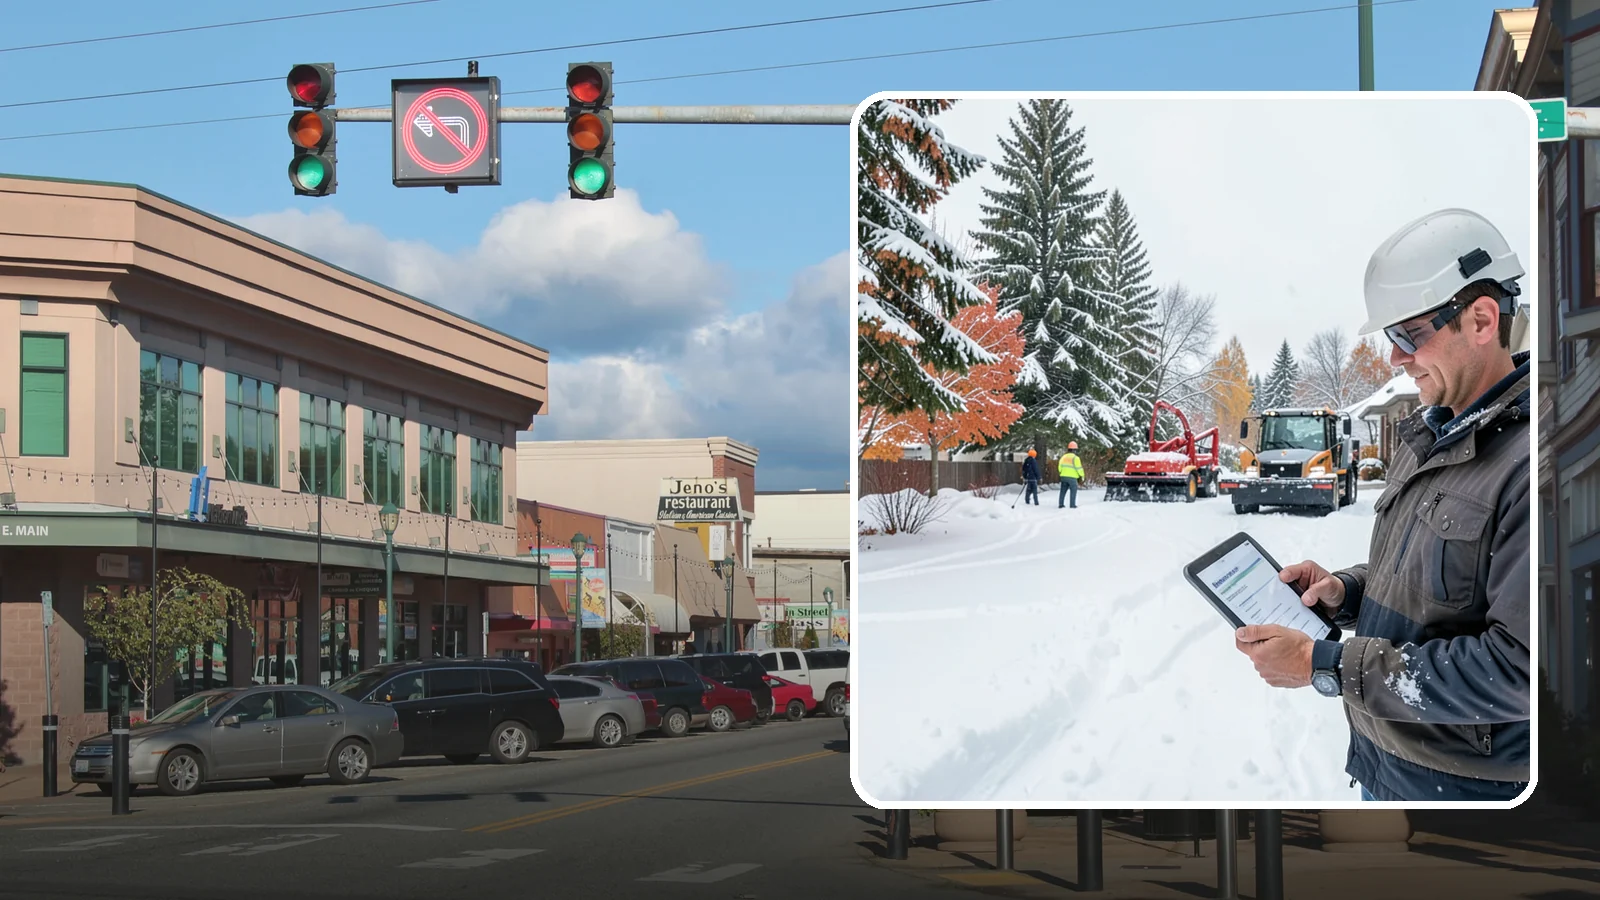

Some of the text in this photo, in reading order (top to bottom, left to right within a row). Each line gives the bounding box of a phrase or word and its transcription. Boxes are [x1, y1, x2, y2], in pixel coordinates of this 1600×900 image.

[670, 480, 727, 494] Jeno's
[665, 496, 731, 509] restaurant
[659, 510, 681, 520] Italian
[686, 509, 714, 519] American
[715, 509, 738, 519] Cuisine
[2, 525, 49, 536] E. MAIN
[797, 607, 828, 617] Street
